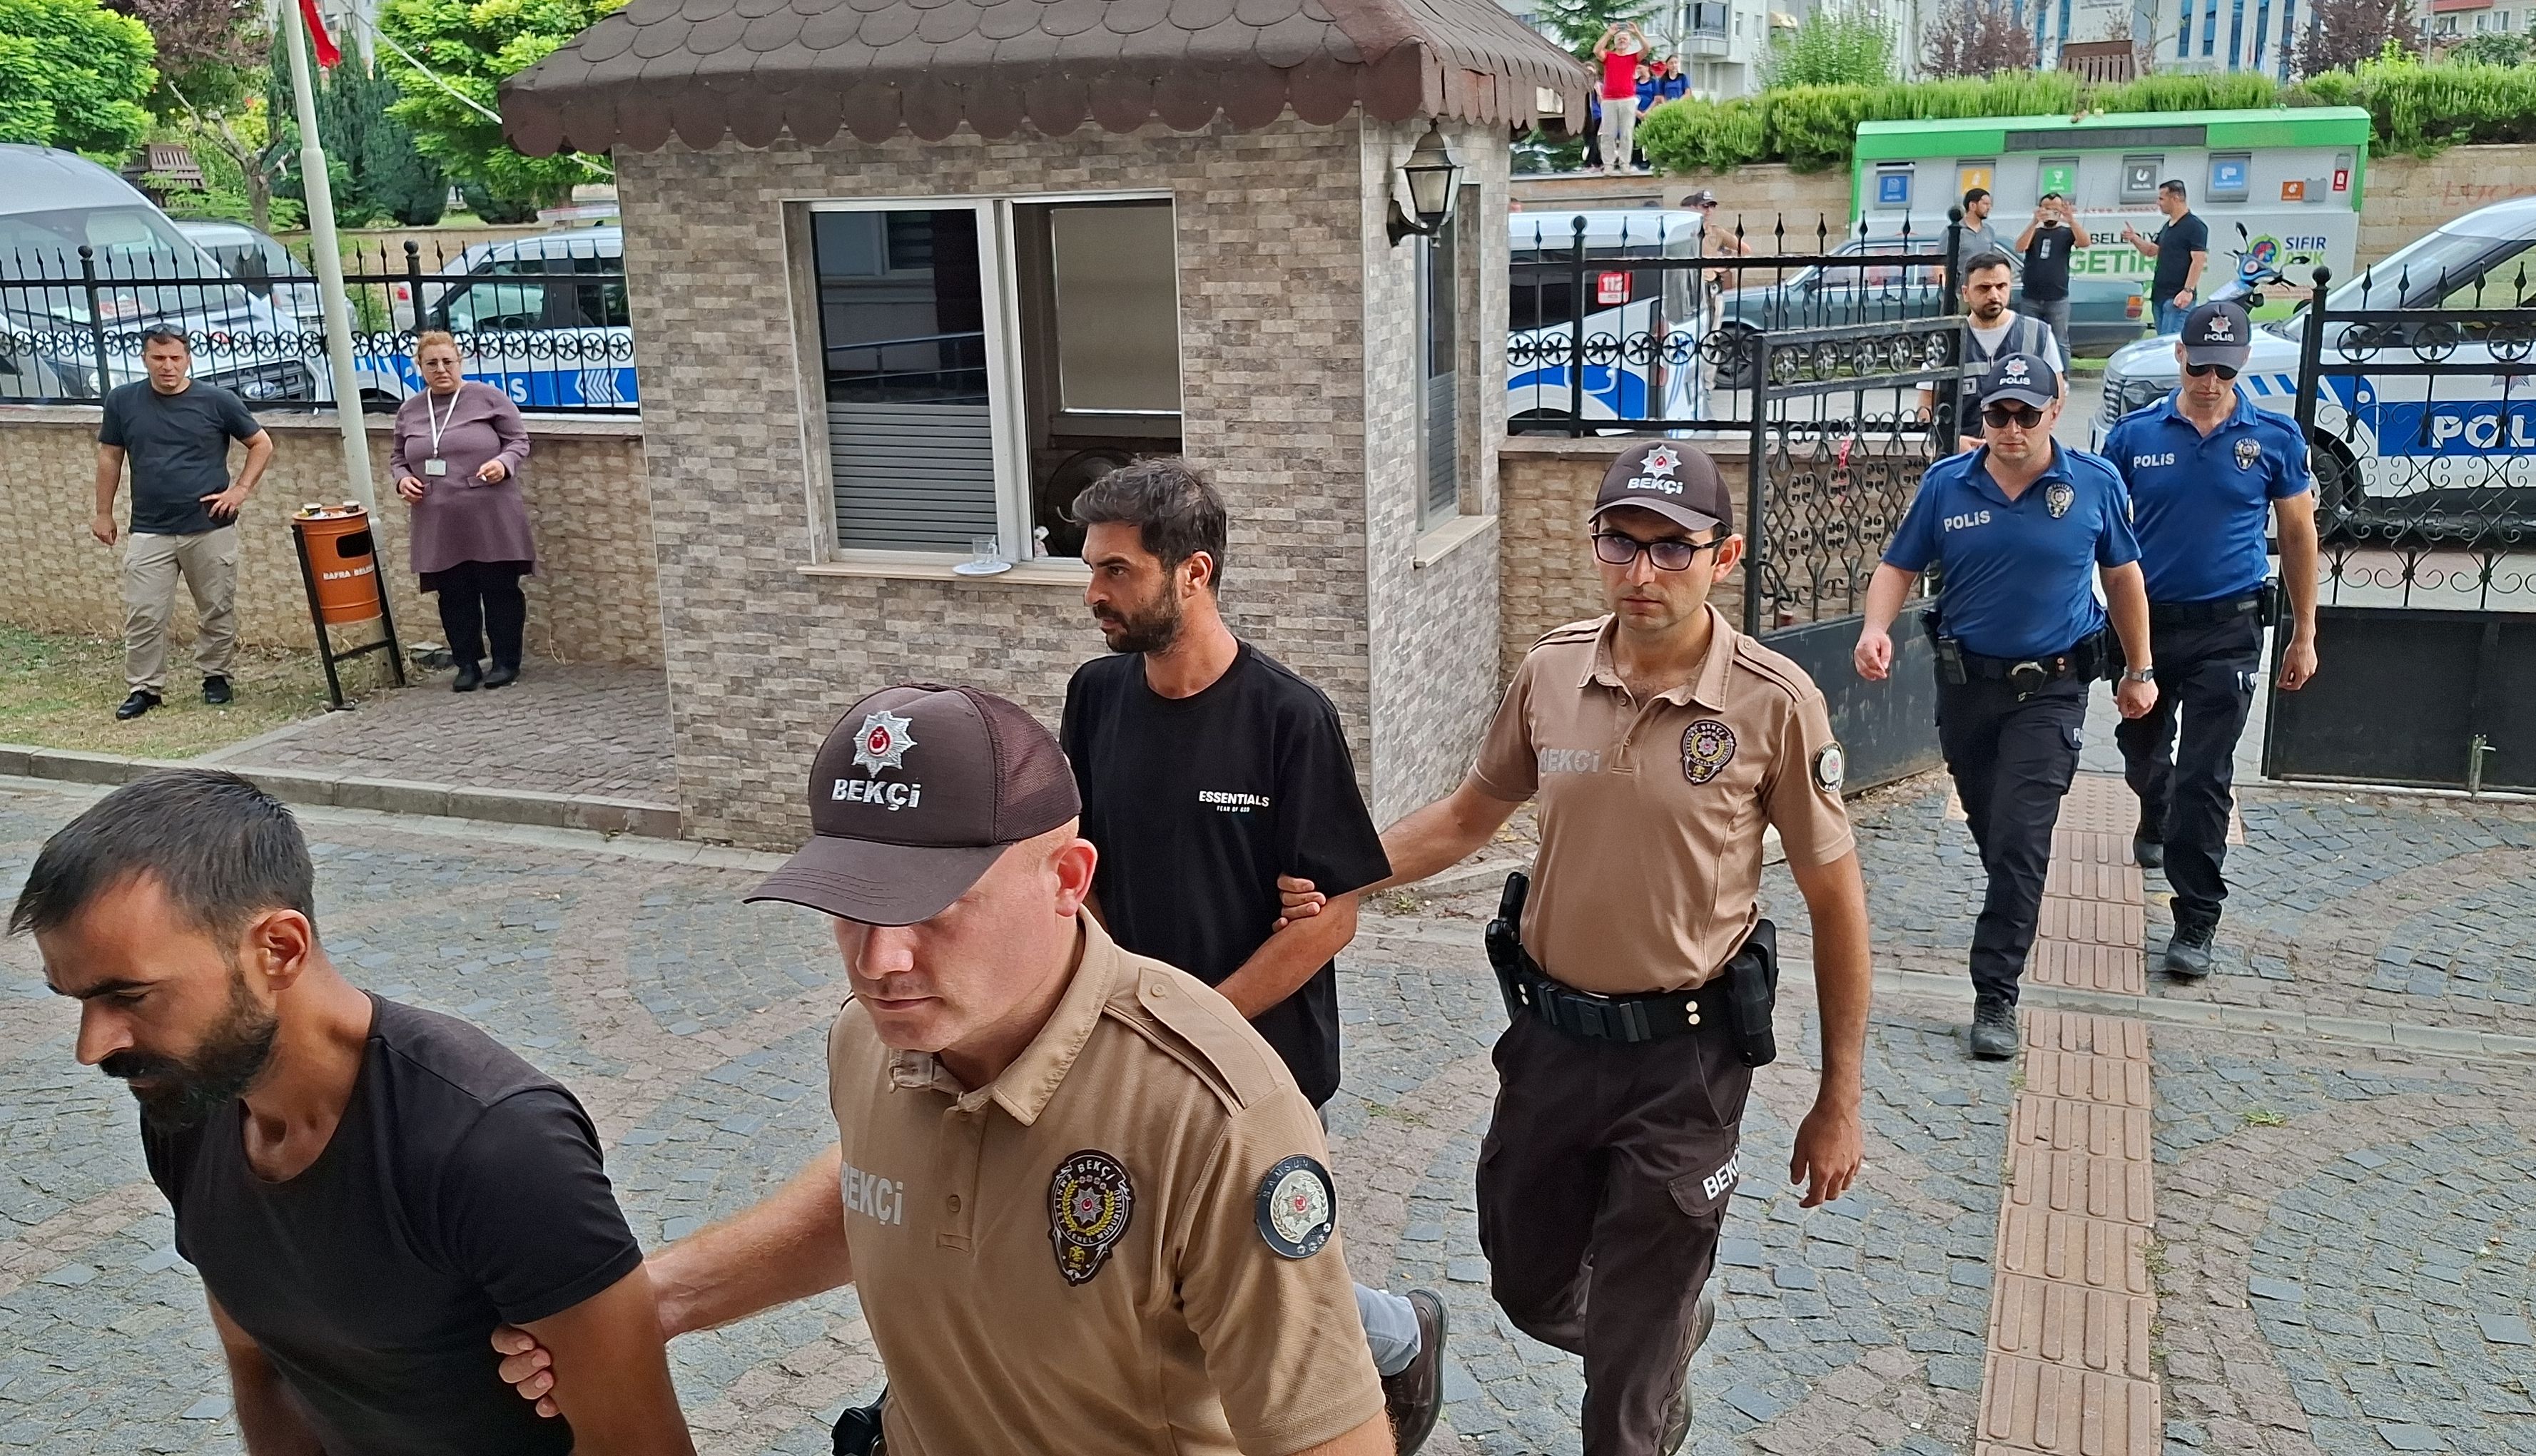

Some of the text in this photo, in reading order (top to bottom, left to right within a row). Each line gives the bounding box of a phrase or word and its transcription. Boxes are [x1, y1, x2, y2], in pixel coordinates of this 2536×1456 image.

[2285, 237, 2327, 250] SIFIR
[1602, 275, 1623, 292] 112
[1199, 790, 1269, 807] ESSENTIALS
